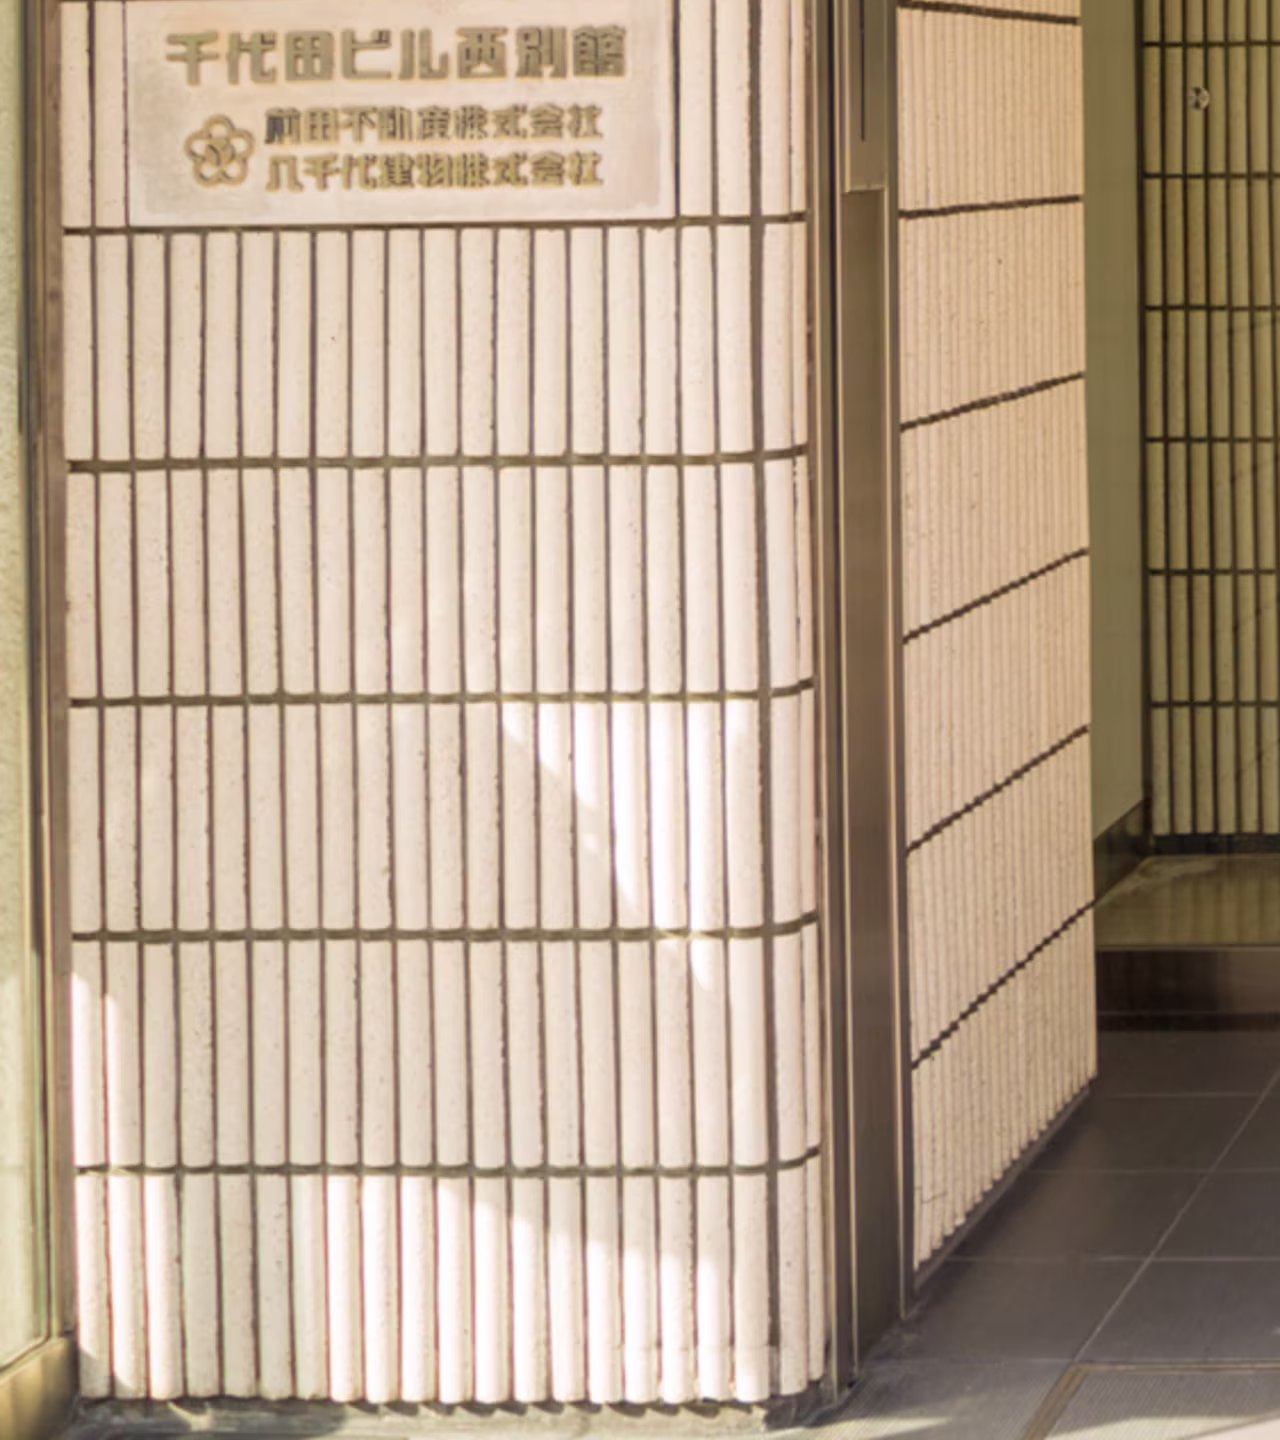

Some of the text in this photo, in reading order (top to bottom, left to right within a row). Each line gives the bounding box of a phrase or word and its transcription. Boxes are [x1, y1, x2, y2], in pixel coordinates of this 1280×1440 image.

[165, 26, 628, 86] 千代田ビル西別館
